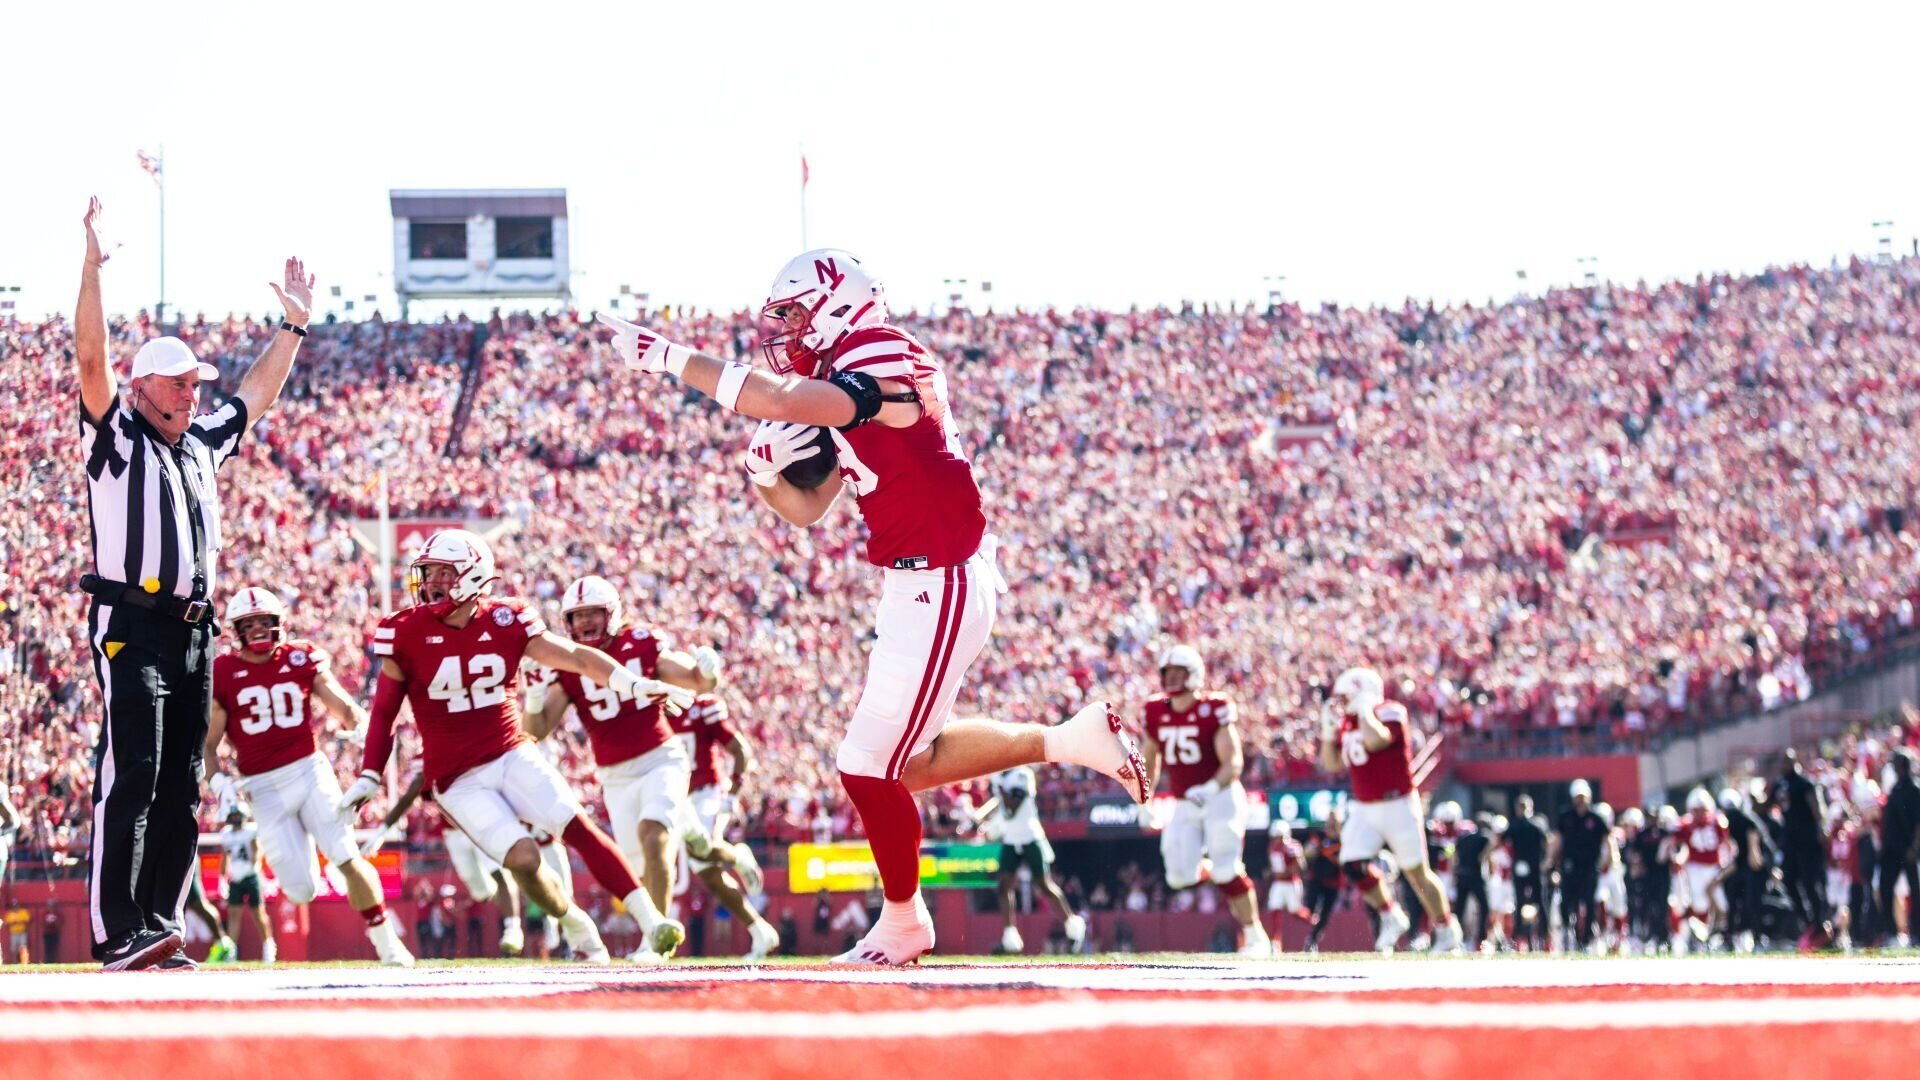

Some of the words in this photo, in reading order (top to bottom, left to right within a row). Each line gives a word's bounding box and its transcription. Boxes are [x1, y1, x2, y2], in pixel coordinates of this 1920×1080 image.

[814, 257, 838, 284] N
[427, 653, 506, 713] 42
[524, 668, 542, 687] N
[236, 681, 304, 736] 30
[1158, 726, 1202, 765] 75
